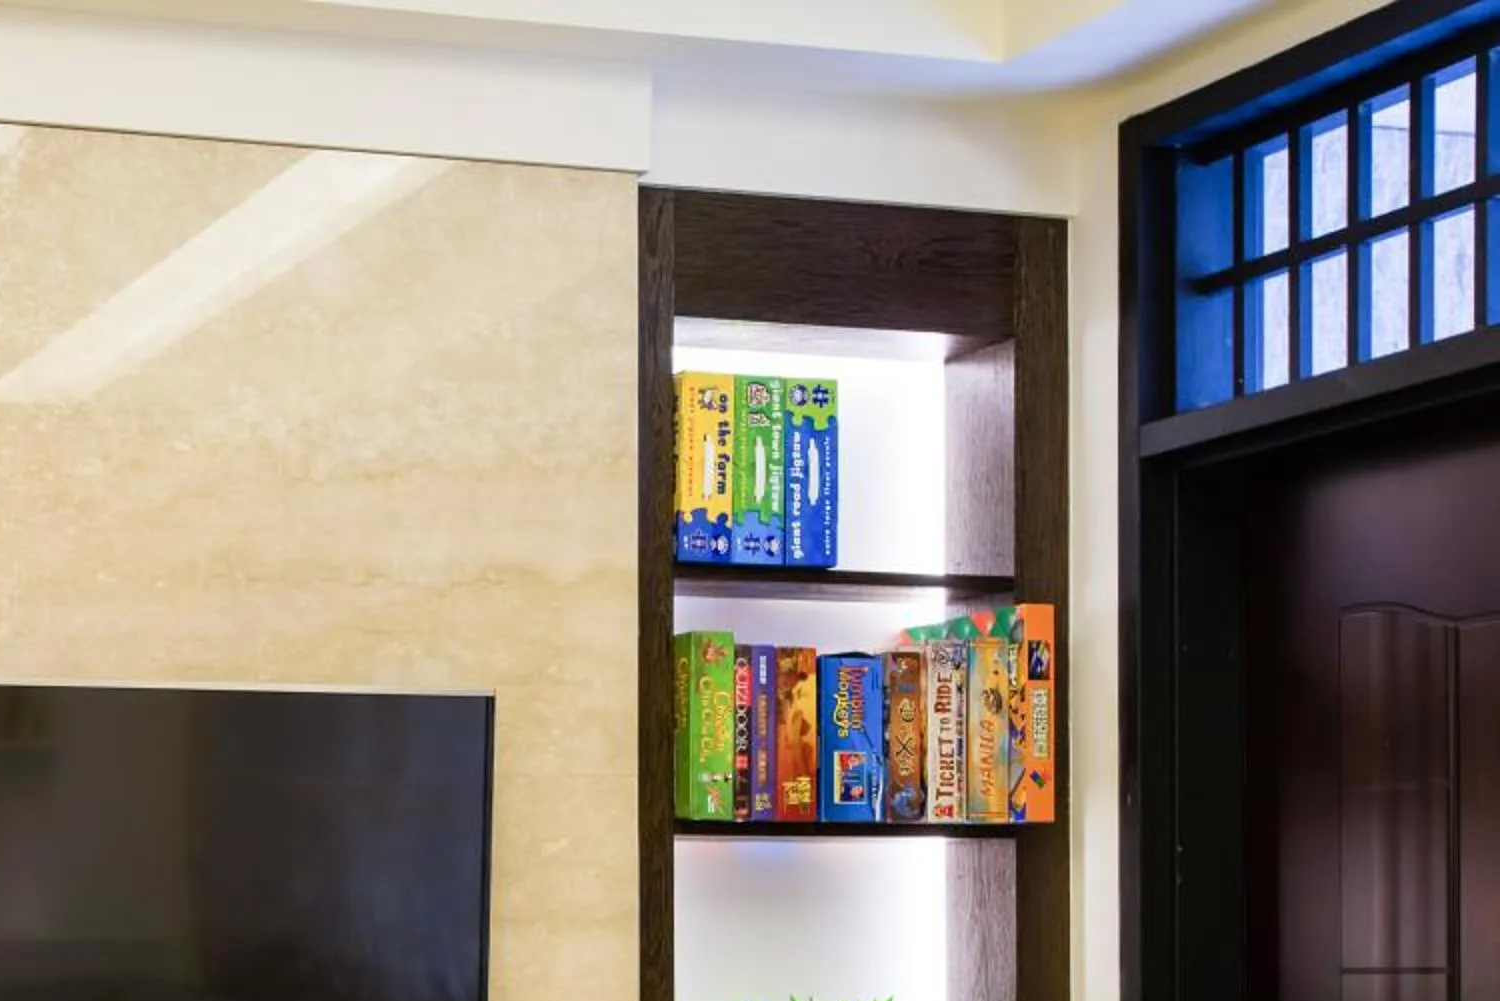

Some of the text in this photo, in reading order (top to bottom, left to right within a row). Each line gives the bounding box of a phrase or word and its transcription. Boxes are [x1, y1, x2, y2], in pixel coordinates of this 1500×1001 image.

[770, 380, 782, 418] giant
[771, 423, 782, 459] town
[717, 393, 731, 495] on the farm
[790, 431, 804, 559] giant road jigsaw
[934, 671, 955, 801] TICKET TO RIDE
[979, 720, 994, 797] MANILA
